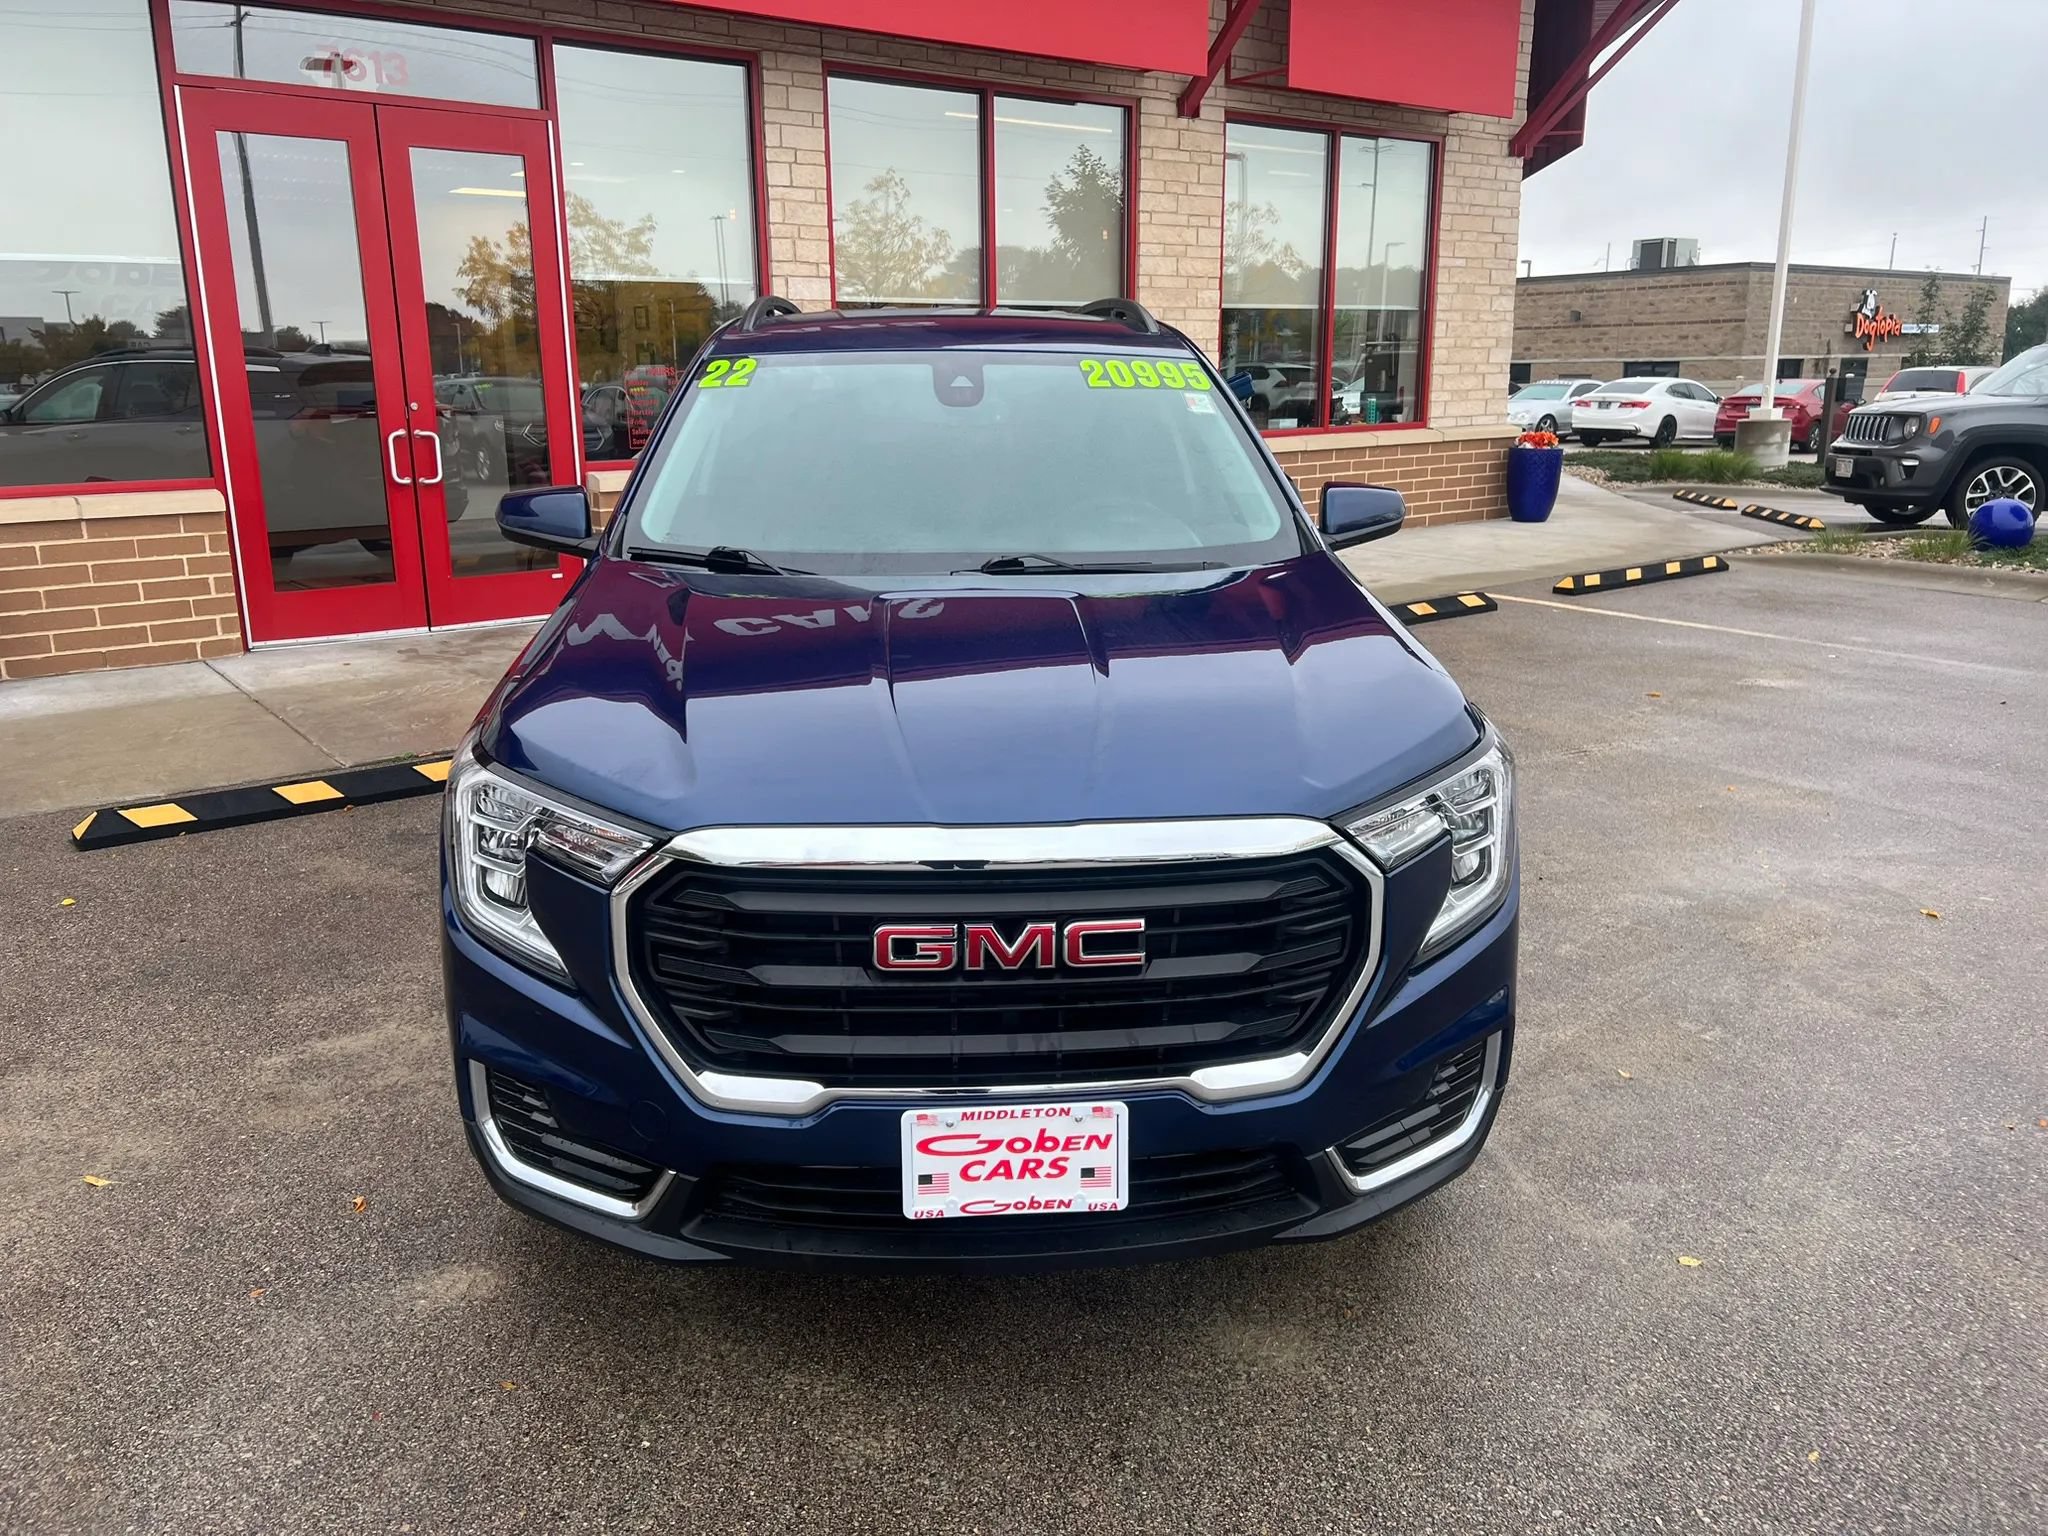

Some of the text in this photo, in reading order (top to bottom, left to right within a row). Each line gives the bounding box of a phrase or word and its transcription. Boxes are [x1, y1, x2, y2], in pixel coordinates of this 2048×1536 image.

[1855, 304, 1902, 352] Dogtopia
[698, 358, 757, 388] 22
[1079, 359, 1211, 391] 20995
[873, 918, 1146, 971] GMC
[960, 1107, 1072, 1122] MIDDLETON
[959, 1157, 1070, 1182] CARS
[913, 1208, 945, 1220] USA
[1087, 1200, 1119, 1212] USA
